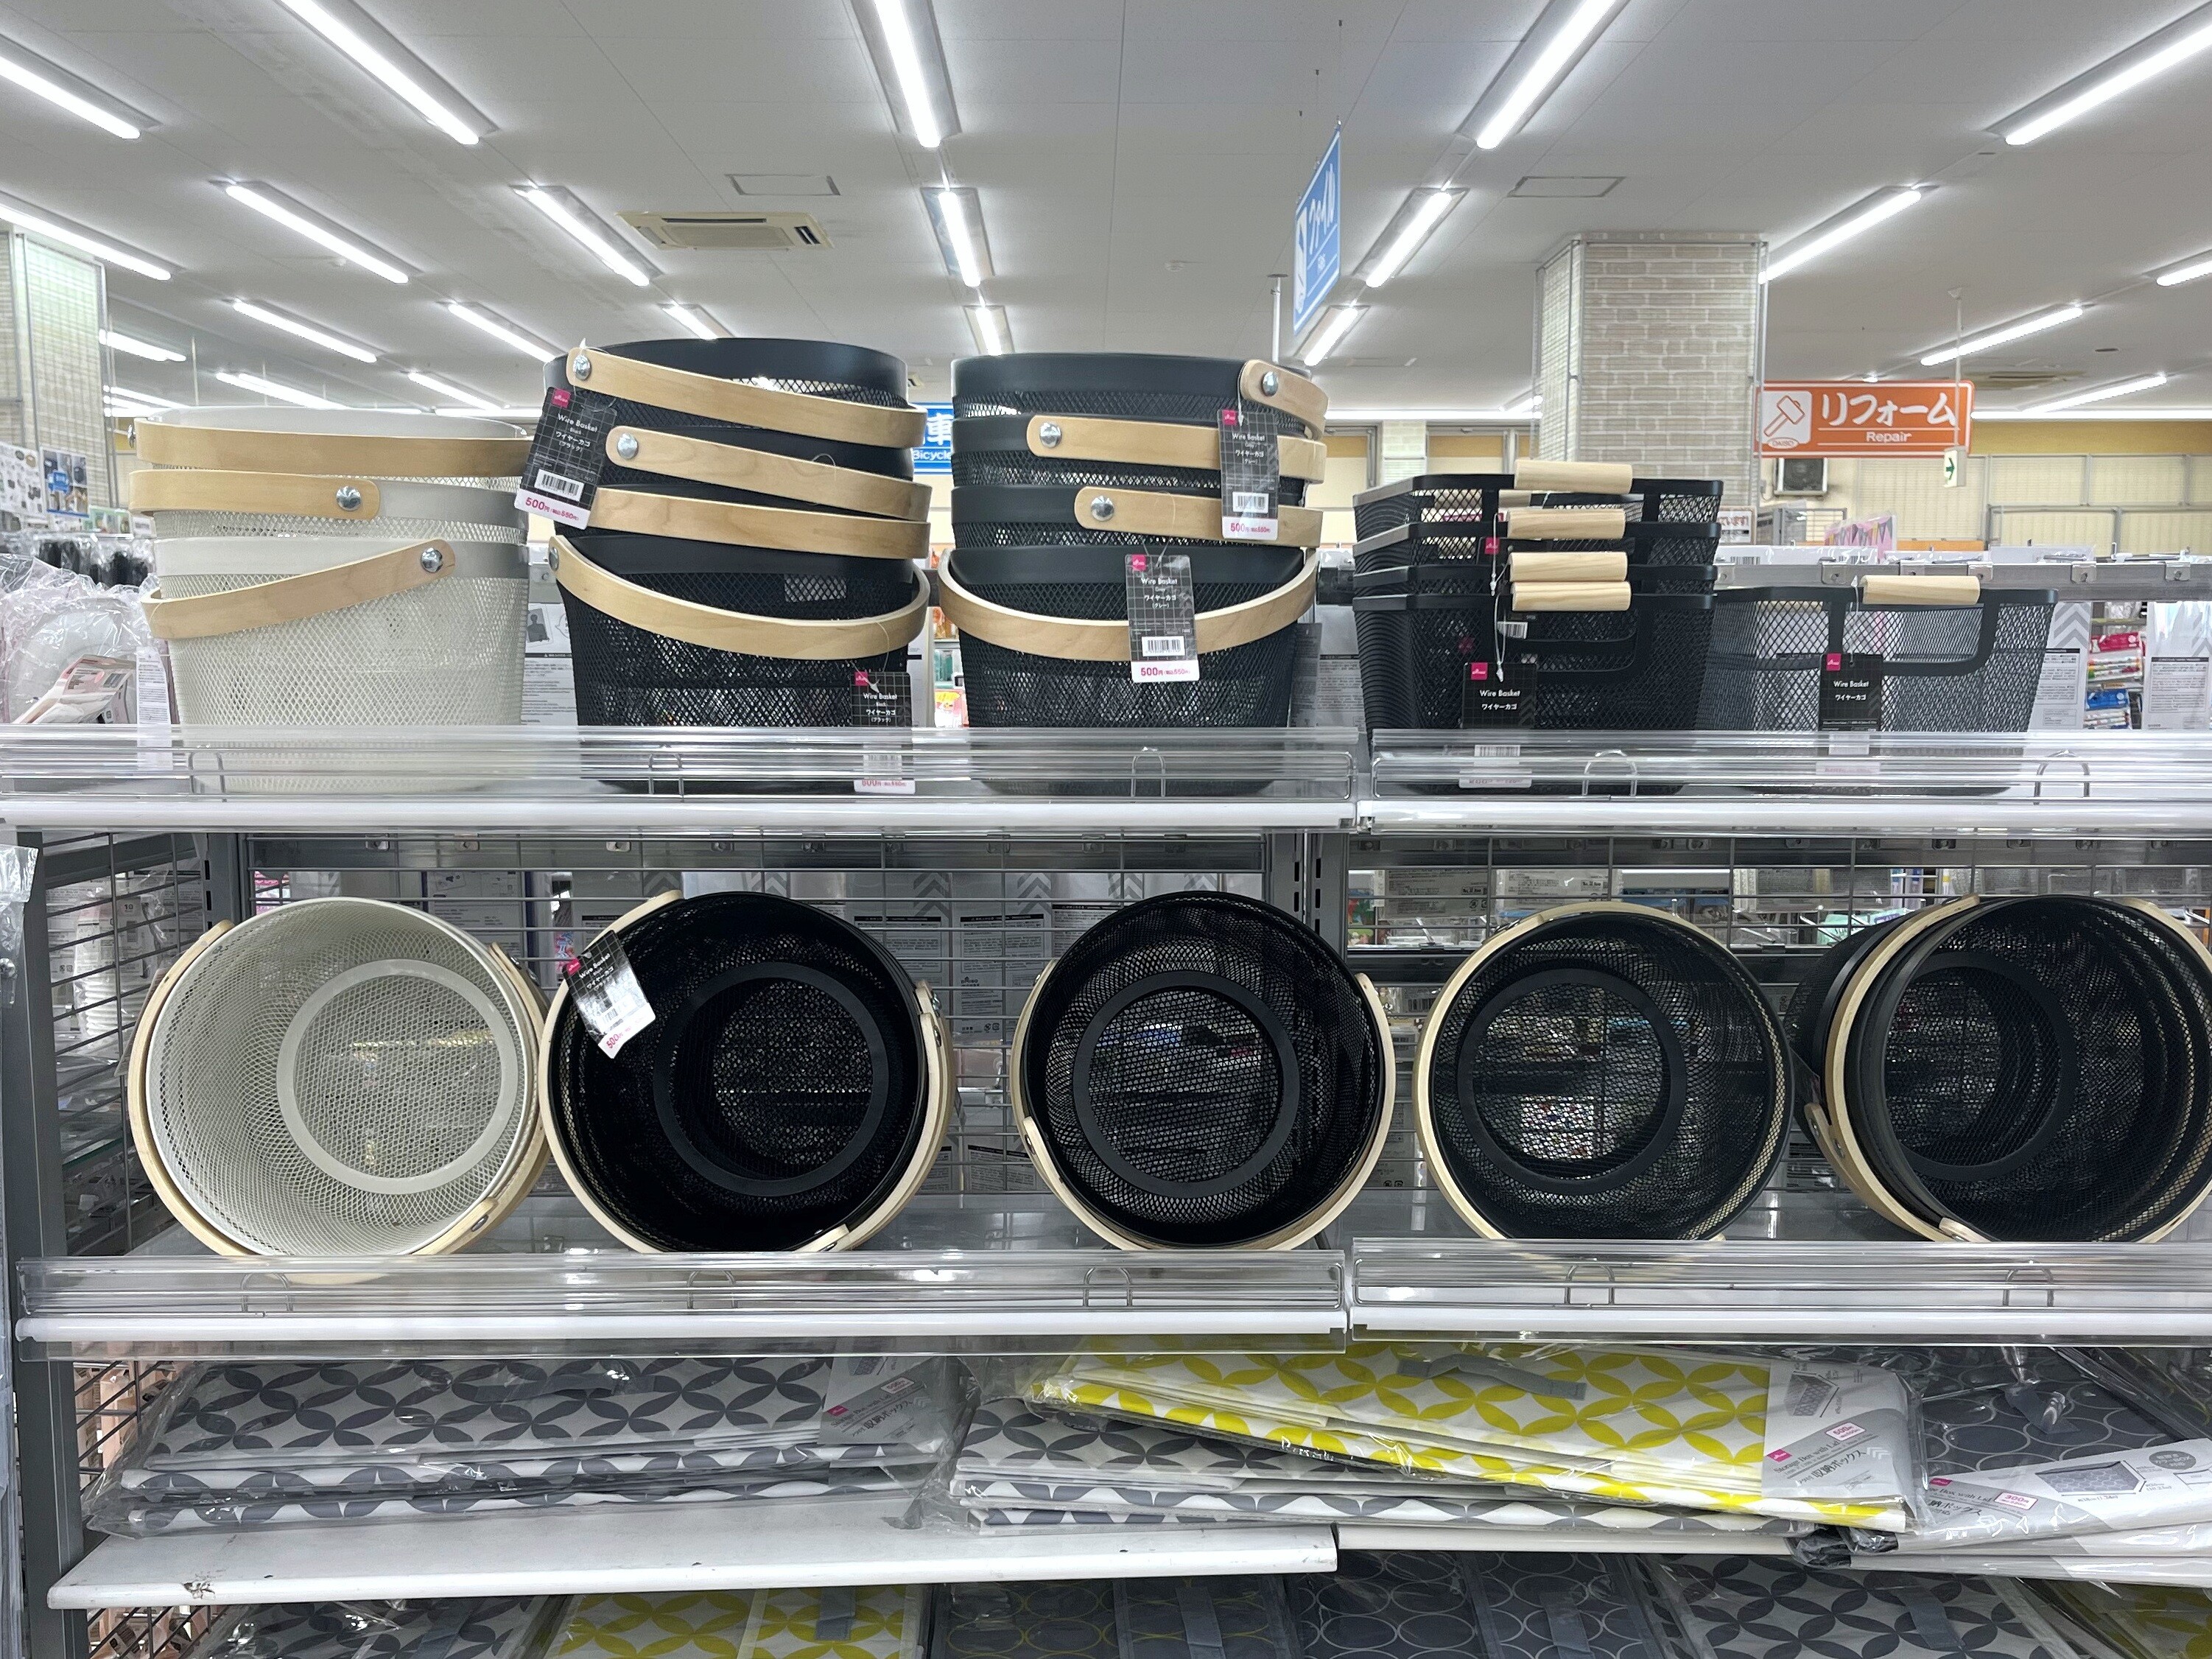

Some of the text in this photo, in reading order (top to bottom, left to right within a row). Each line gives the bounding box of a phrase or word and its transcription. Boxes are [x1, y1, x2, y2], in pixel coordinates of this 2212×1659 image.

[1822, 392, 1957, 427] リフォーム
[558, 413, 598, 432] Wire Basket
[555, 431, 591, 446] ワイヤーカゴ
[1247, 433, 1265, 441] Basket
[1866, 431, 1912, 443] Repair
[1498, 689, 1520, 697] Basket
[579, 967, 594, 979] Wire
[1773, 1459, 1800, 1473] Storage
[1797, 1453, 1814, 1462] Box
[1813, 1446, 1829, 1455] with
[1811, 1449, 1867, 1478] 収納ボックス
